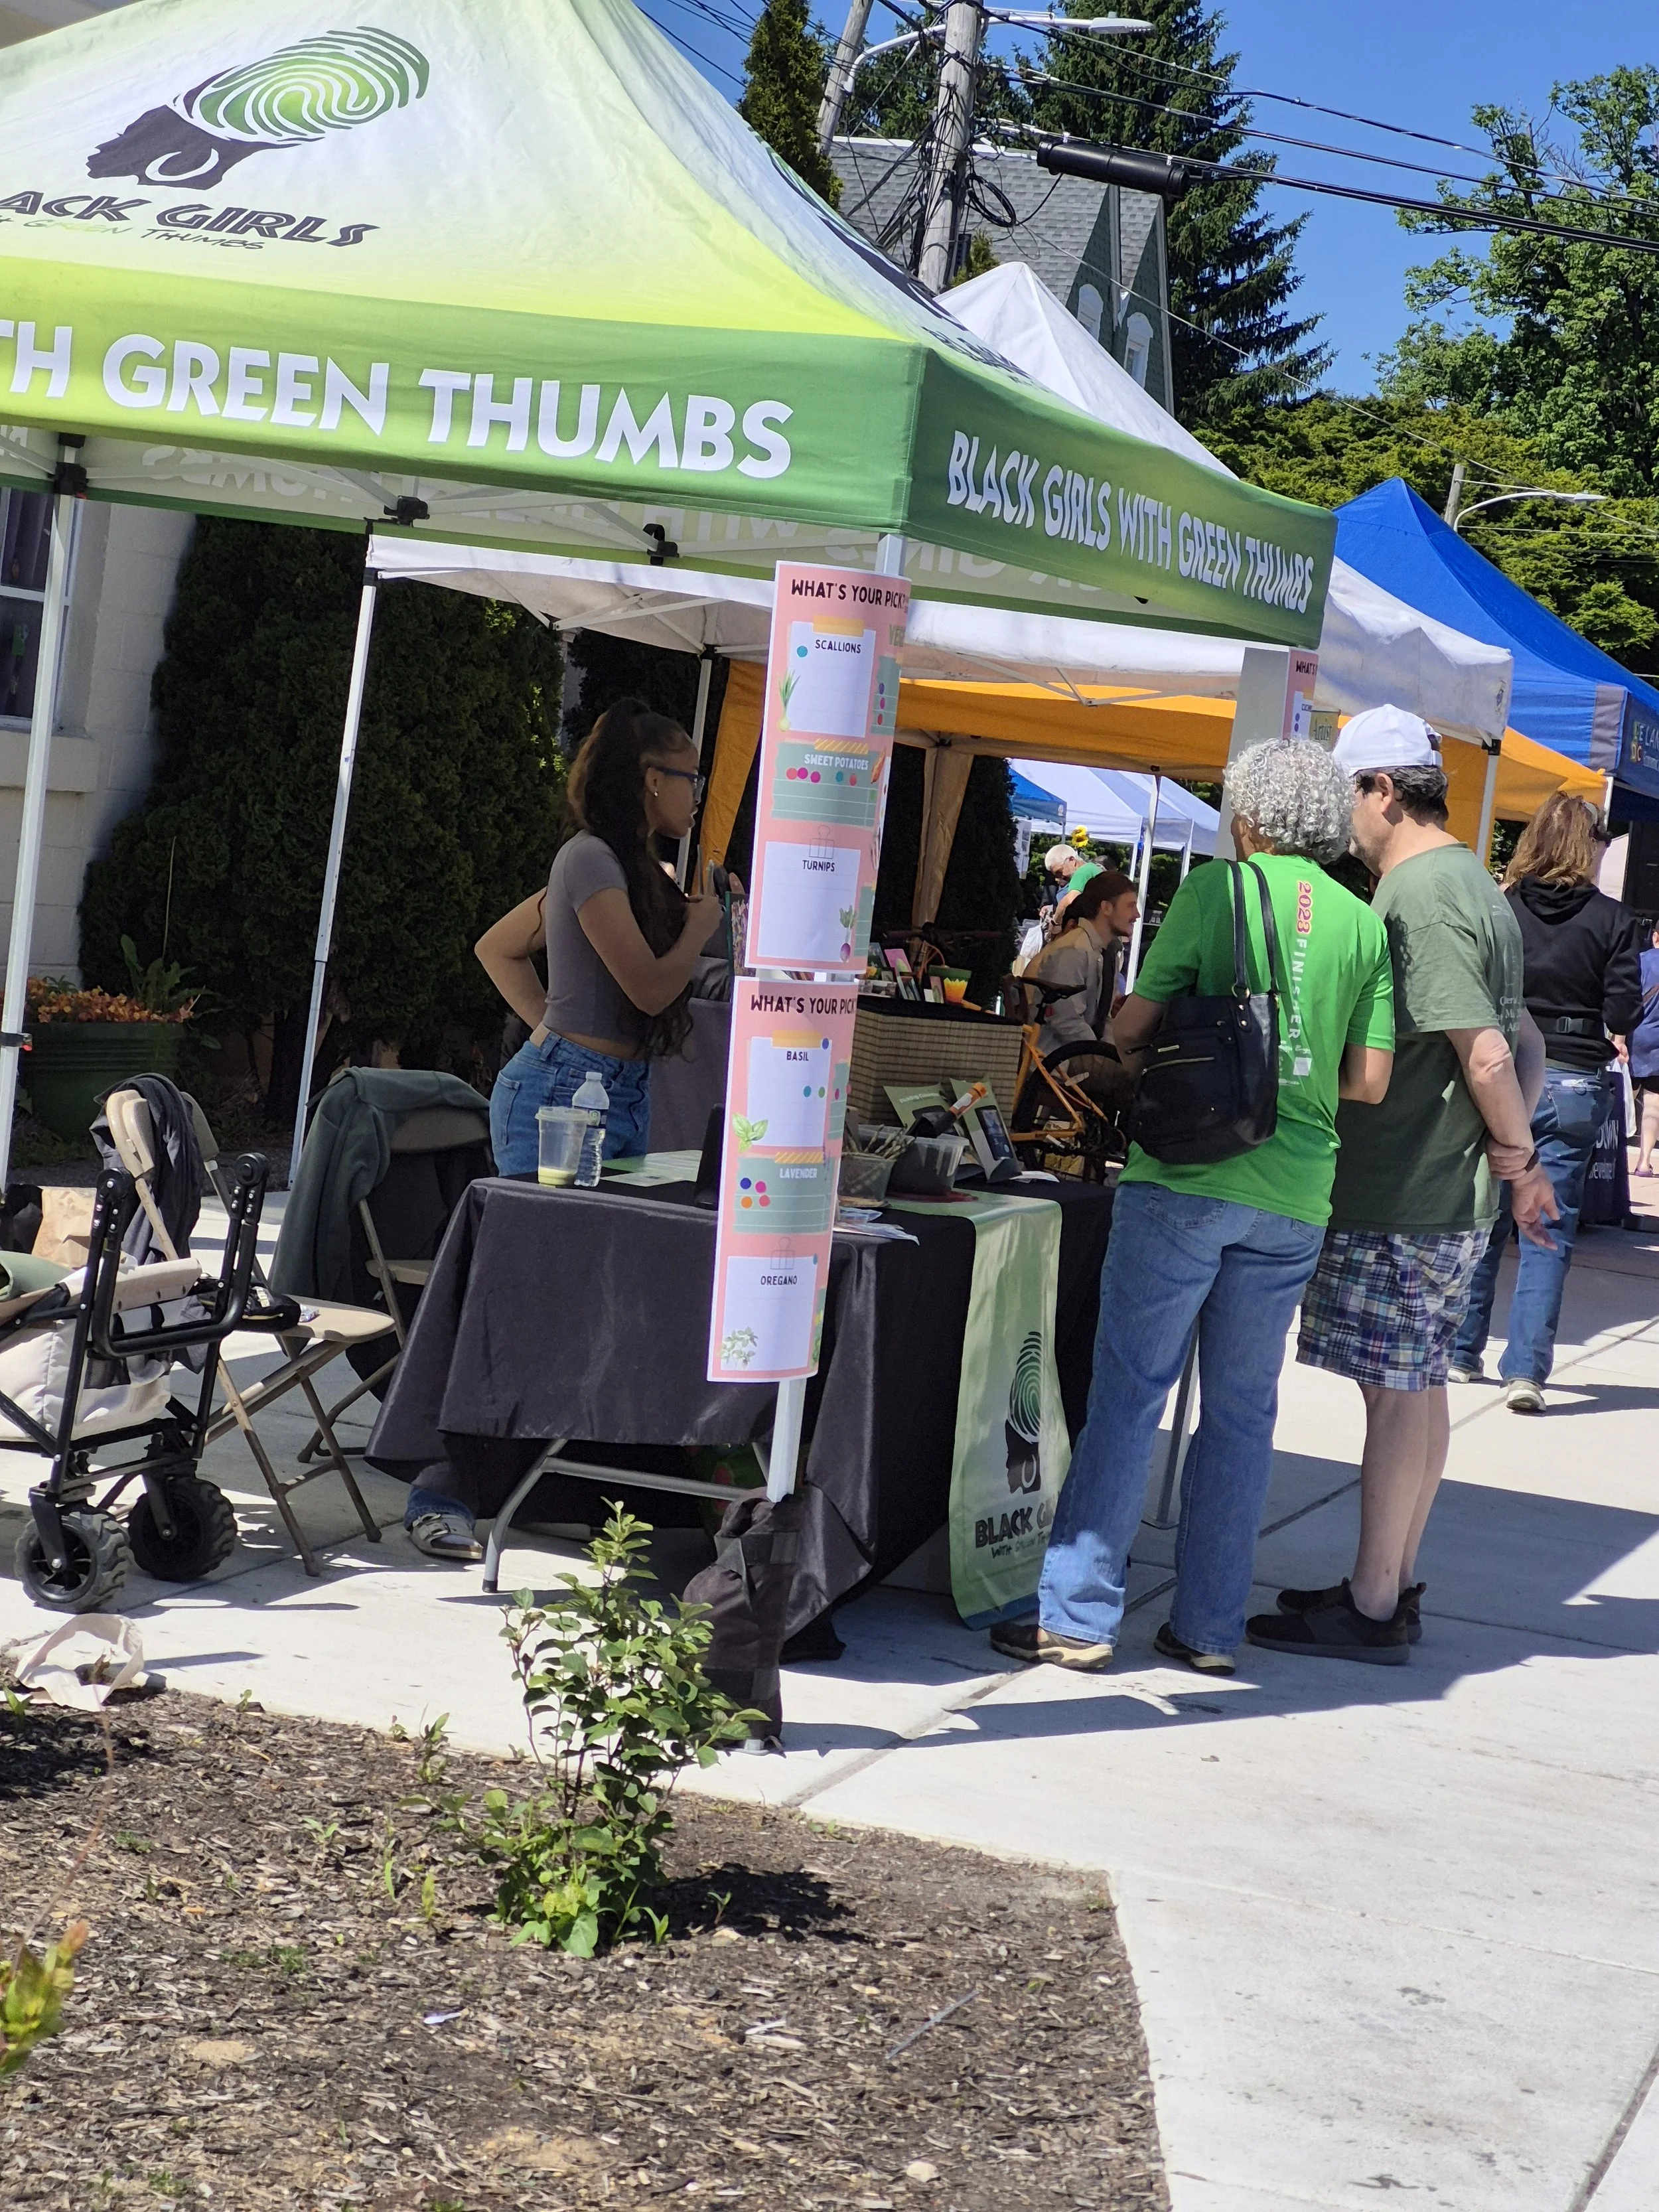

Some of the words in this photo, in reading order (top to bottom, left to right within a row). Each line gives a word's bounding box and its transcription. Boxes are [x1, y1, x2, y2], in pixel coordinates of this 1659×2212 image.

[23, 219, 133, 234] GREEN
[140, 228, 265, 250] THUMBS
[157, 204, 380, 247] GIRLS
[102, 333, 390, 437] GREEN
[418, 368, 794, 479] THUMBS
[946, 430, 1040, 530] BLACK
[1043, 465, 1112, 552] GIRLS
[1118, 488, 1172, 570] WITH
[1178, 512, 1241, 591] GREEN
[1243, 536, 1315, 614] THUMBS
[791, 579, 847, 601] WHAT'S
[851, 585, 882, 606] YOUR
[815, 639, 861, 654] SCALLIONS
[804, 753, 833, 767] SWEET
[835, 757, 869, 771] POTATOES
[802, 859, 835, 873] TURNIPS
[1296, 879, 1314, 934] 2023
[751, 994, 805, 1014] WHAT'S
[809, 997, 837, 1015] YOUR
[786, 1050, 809, 1062] BASIL
[779, 1167, 818, 1179] LAVENDER
[760, 1274, 798, 1286] OREGANO
[975, 1506, 1034, 1549] BLACK
